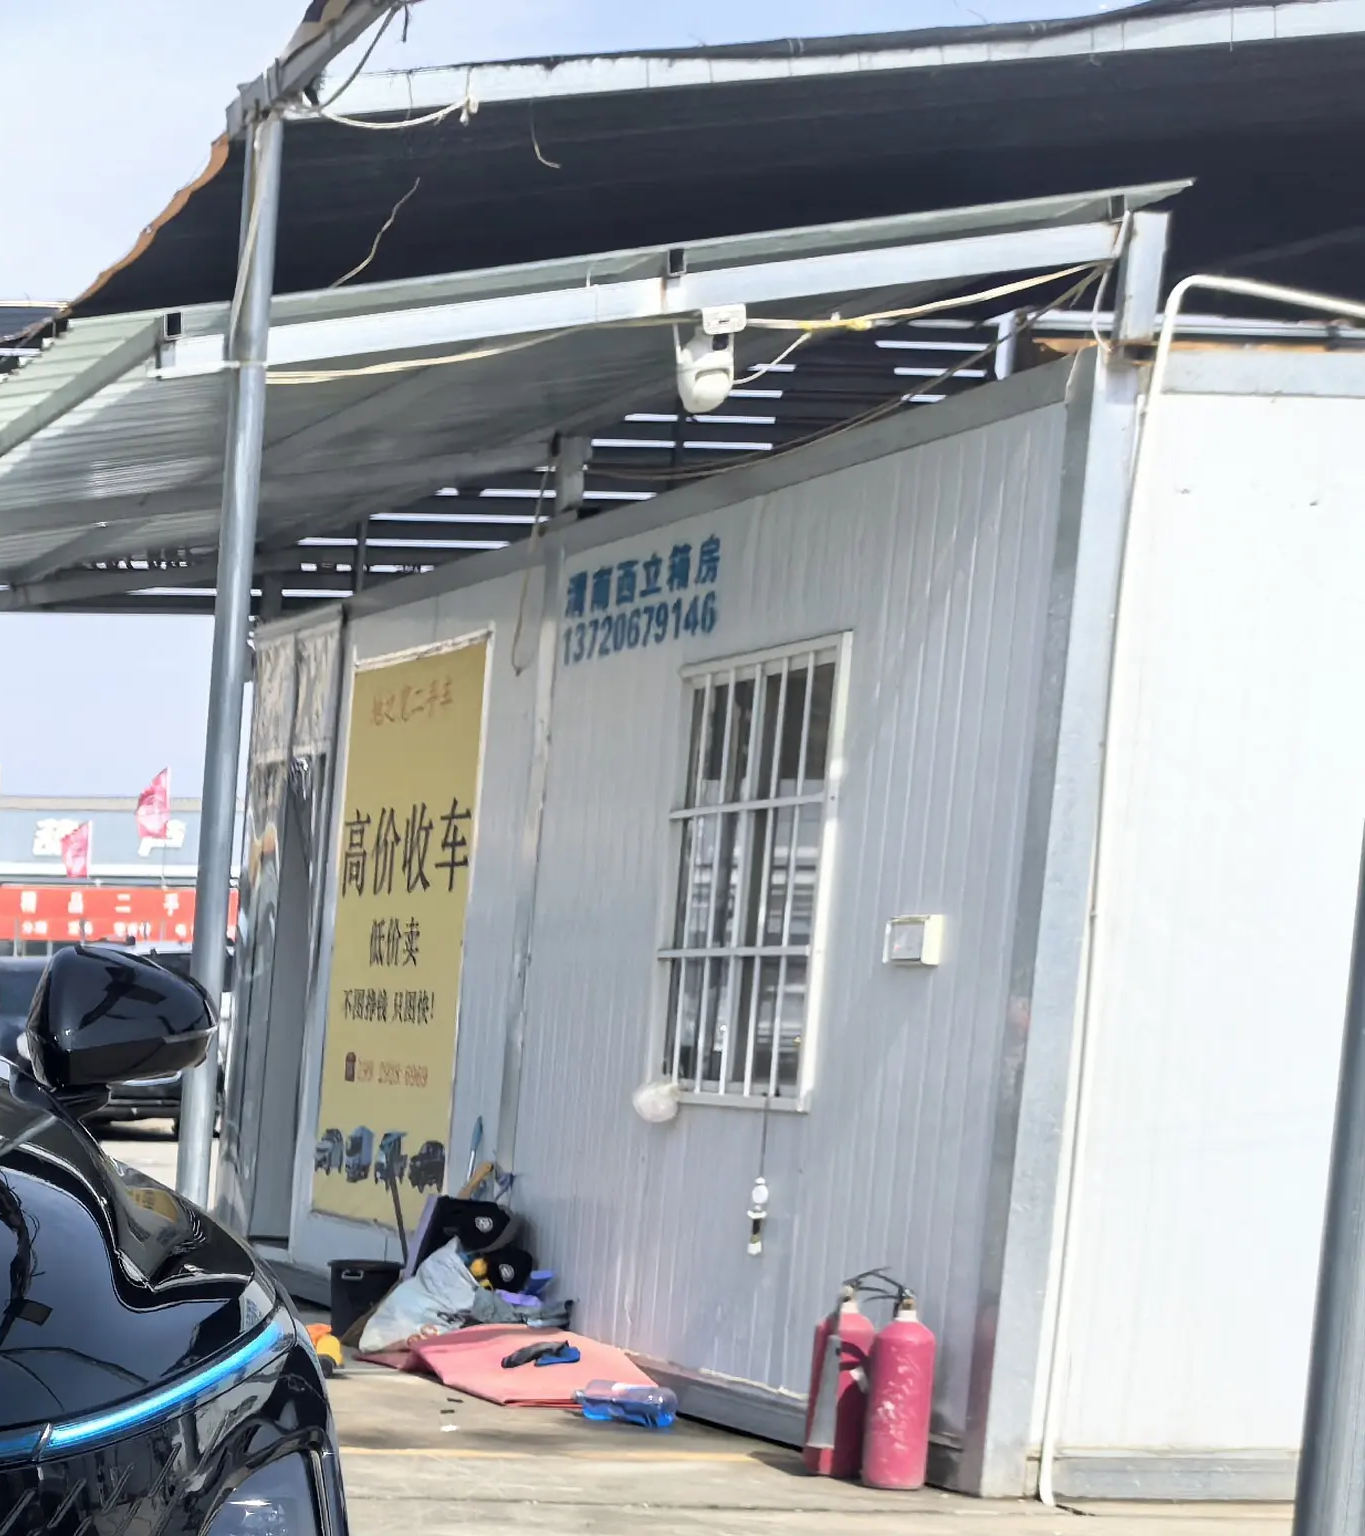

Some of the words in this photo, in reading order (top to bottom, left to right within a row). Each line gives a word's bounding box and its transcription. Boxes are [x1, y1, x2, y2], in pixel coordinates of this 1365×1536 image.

[562, 591, 718, 665] 13720679146
[342, 796, 472, 897] 高价收车
[369, 917, 421, 967] 低价卖
